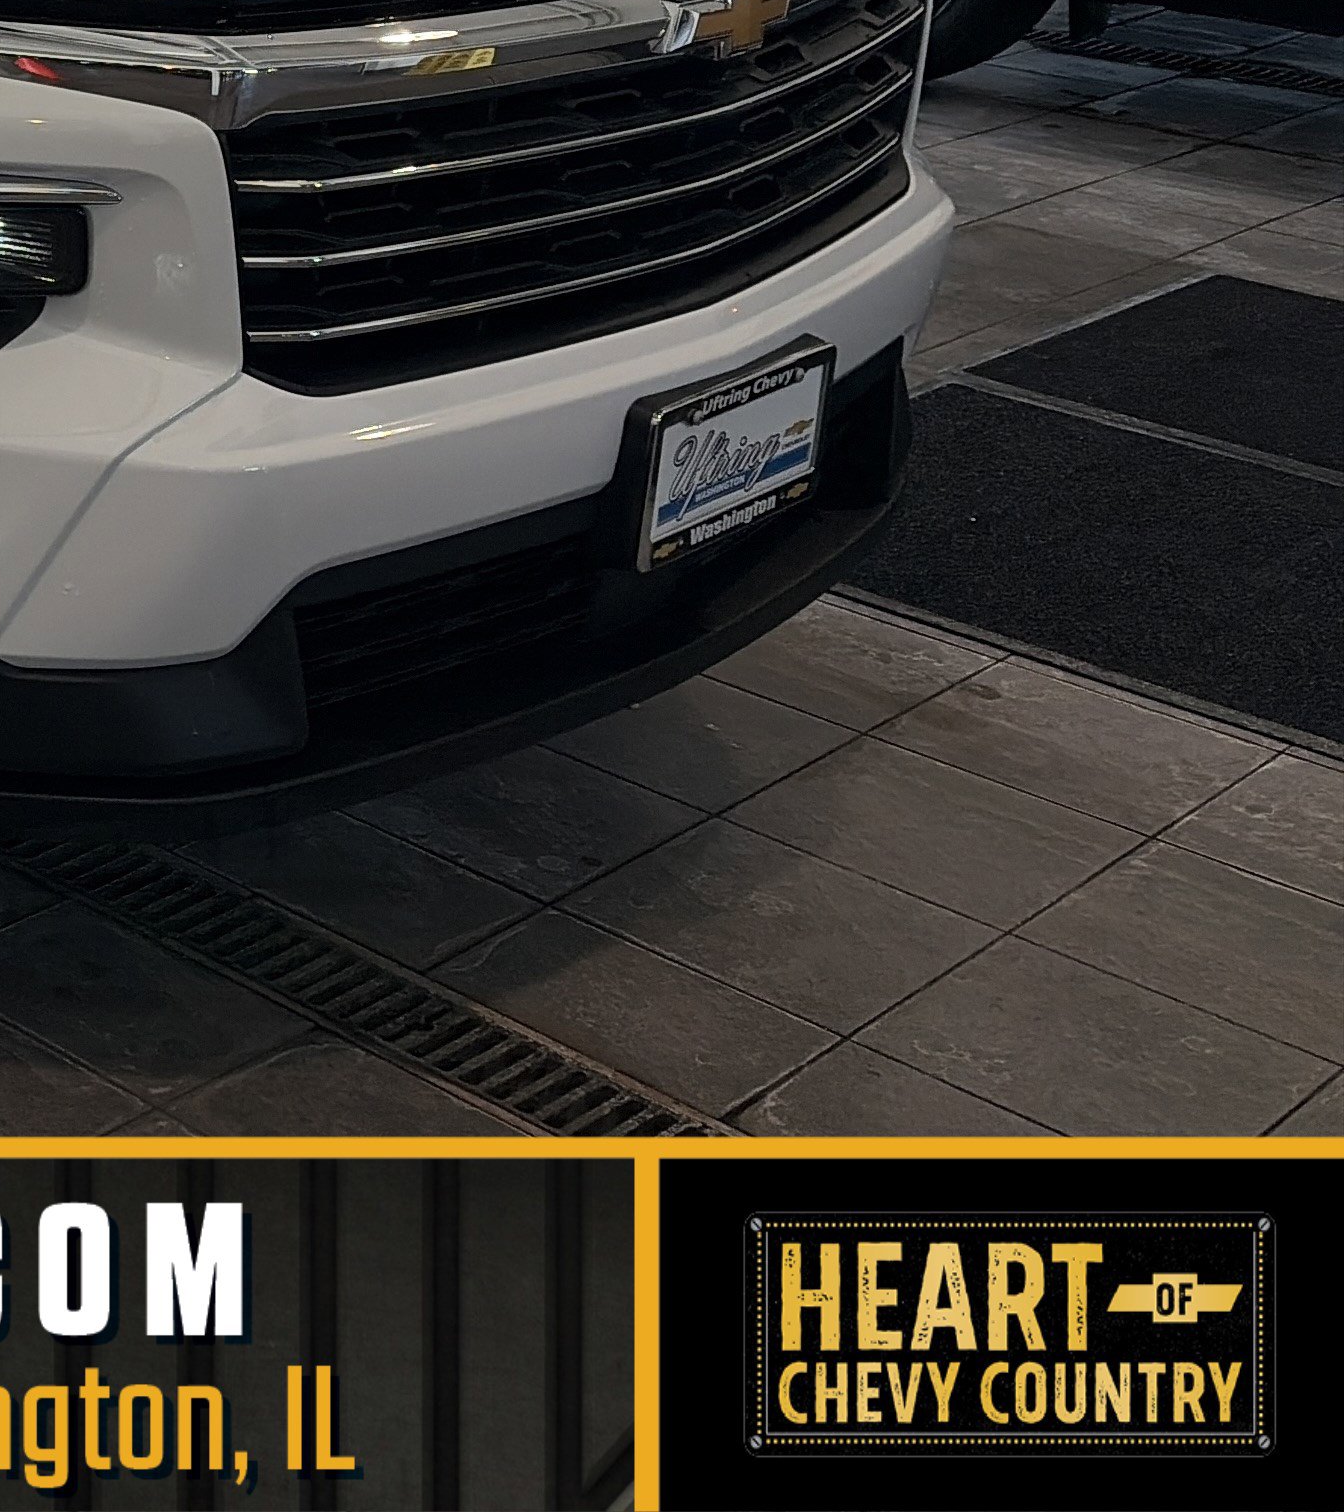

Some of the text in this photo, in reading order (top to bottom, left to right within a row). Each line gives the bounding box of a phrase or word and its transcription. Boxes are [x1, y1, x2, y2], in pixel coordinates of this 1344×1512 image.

[702, 367, 795, 416] Uftring Chevy
[669, 429, 781, 522] Uftring
[695, 475, 746, 503] WASHINGTON
[690, 494, 777, 546] Washington
